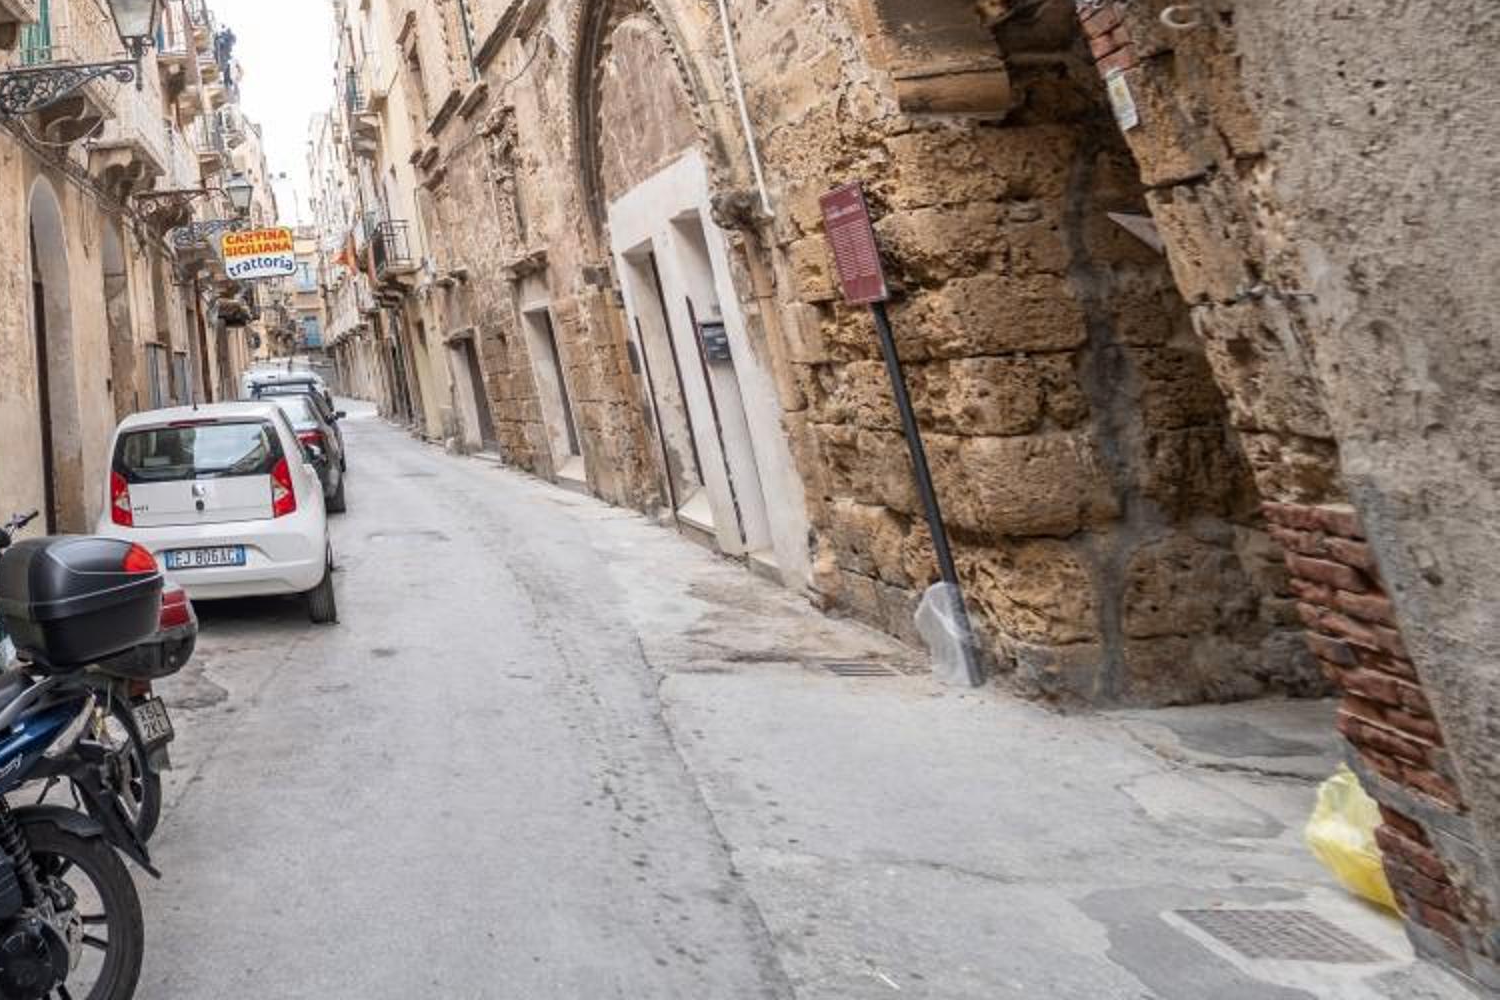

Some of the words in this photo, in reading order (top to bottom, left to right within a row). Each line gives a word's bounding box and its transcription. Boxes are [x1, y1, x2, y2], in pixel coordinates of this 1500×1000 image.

[226, 229, 288, 245] CANTINA
[226, 242, 292, 257] SICILIANA
[228, 255, 293, 277] trattoria
